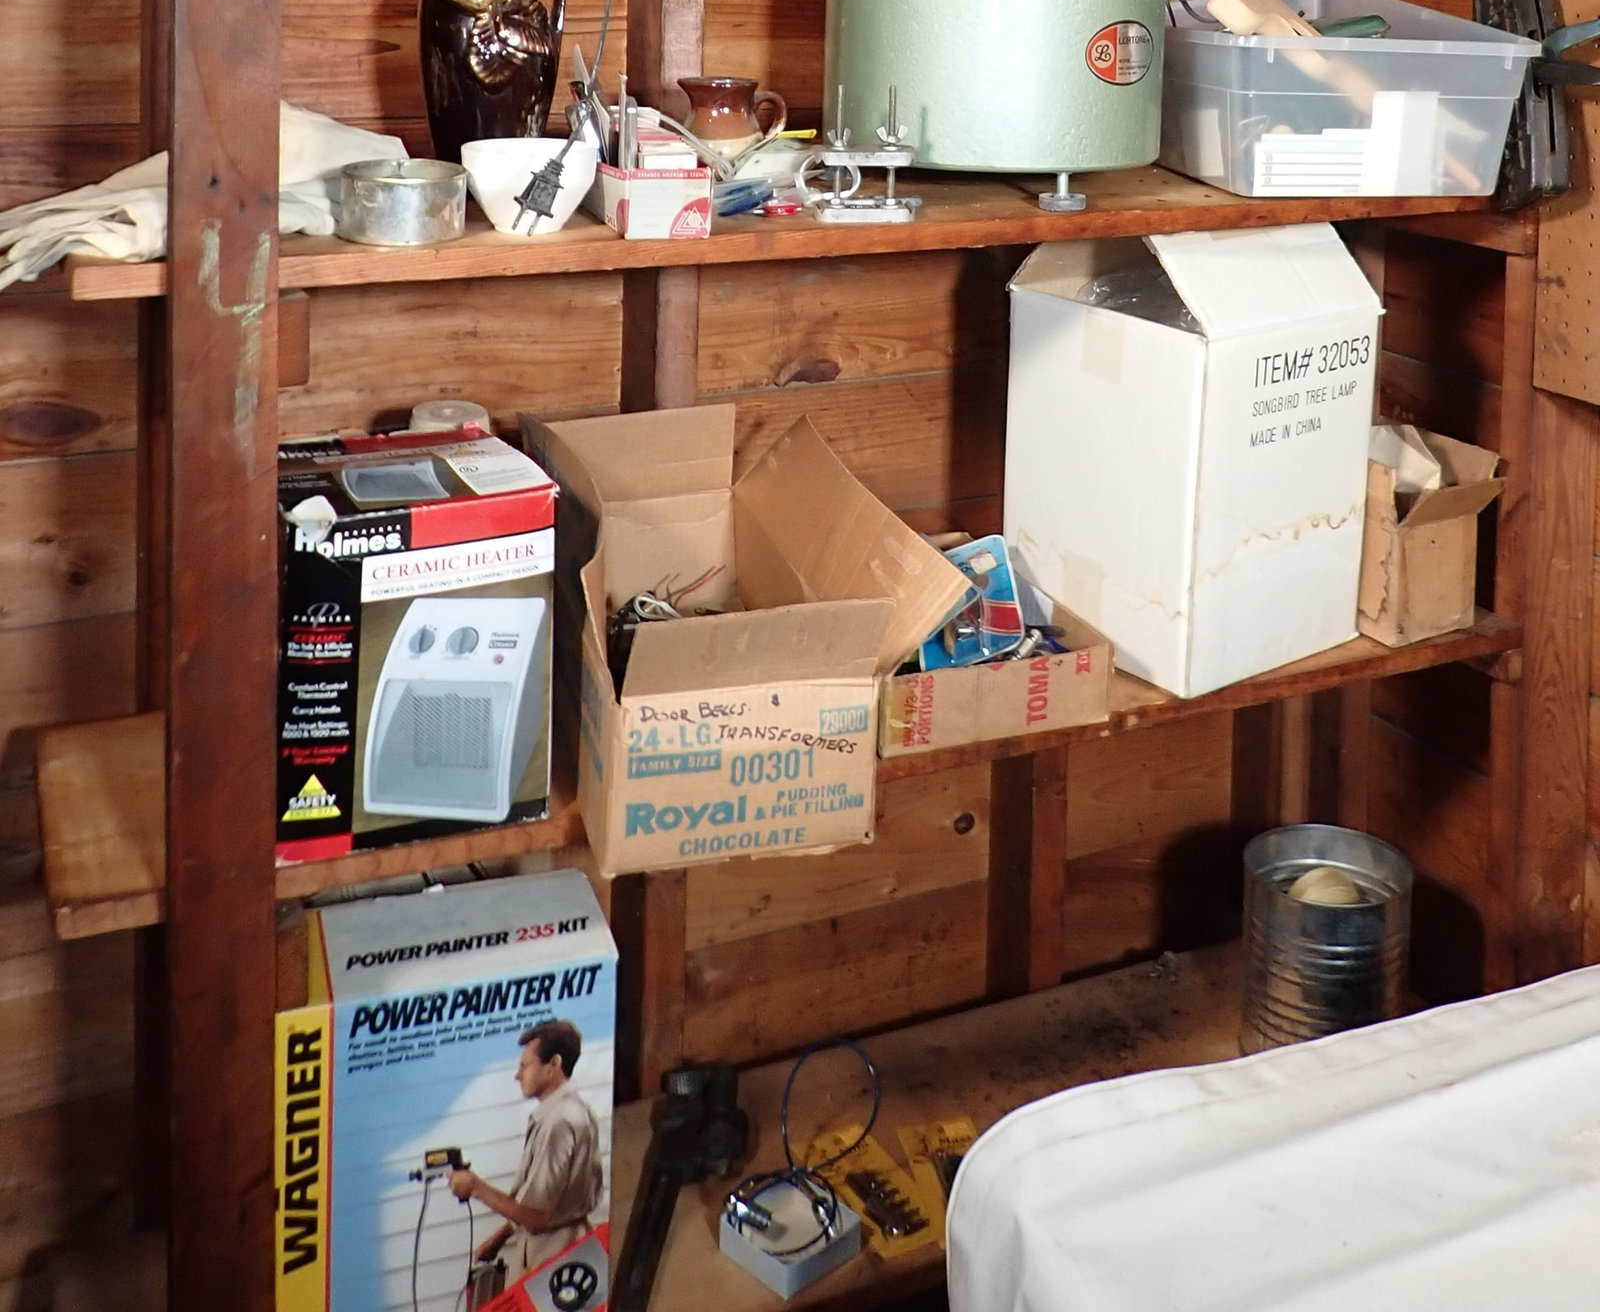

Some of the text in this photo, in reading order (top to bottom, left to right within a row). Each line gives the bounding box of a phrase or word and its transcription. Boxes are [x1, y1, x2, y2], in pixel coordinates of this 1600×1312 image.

[1255, 335, 1370, 388] ITEM# 32053
[1252, 380, 1357, 417] SONGBIRD TREE LAMP
[1250, 417, 1322, 447] MADE IN CHINA
[372, 543, 535, 580] CERAMIC HEATER
[473, 570, 510, 581] COMPACT
[1026, 656, 1050, 726] TOMA
[916, 675, 935, 745] PORTIONS
[718, 724, 858, 754] TRANSFORMERS
[630, 752, 718, 773] FAMILY SIZE
[729, 746, 815, 787] 00301
[289, 794, 336, 810] SAFETY
[754, 793, 865, 820] & PIE FILLING
[776, 783, 848, 803] PUDDING
[624, 794, 748, 838] Royal
[679, 827, 807, 857] CHOCOLATE
[346, 916, 589, 970] POWER PAINTER 235 KIT
[349, 963, 602, 1038] POWER PAINTER KIT
[283, 1027, 322, 1275] WAGNER
